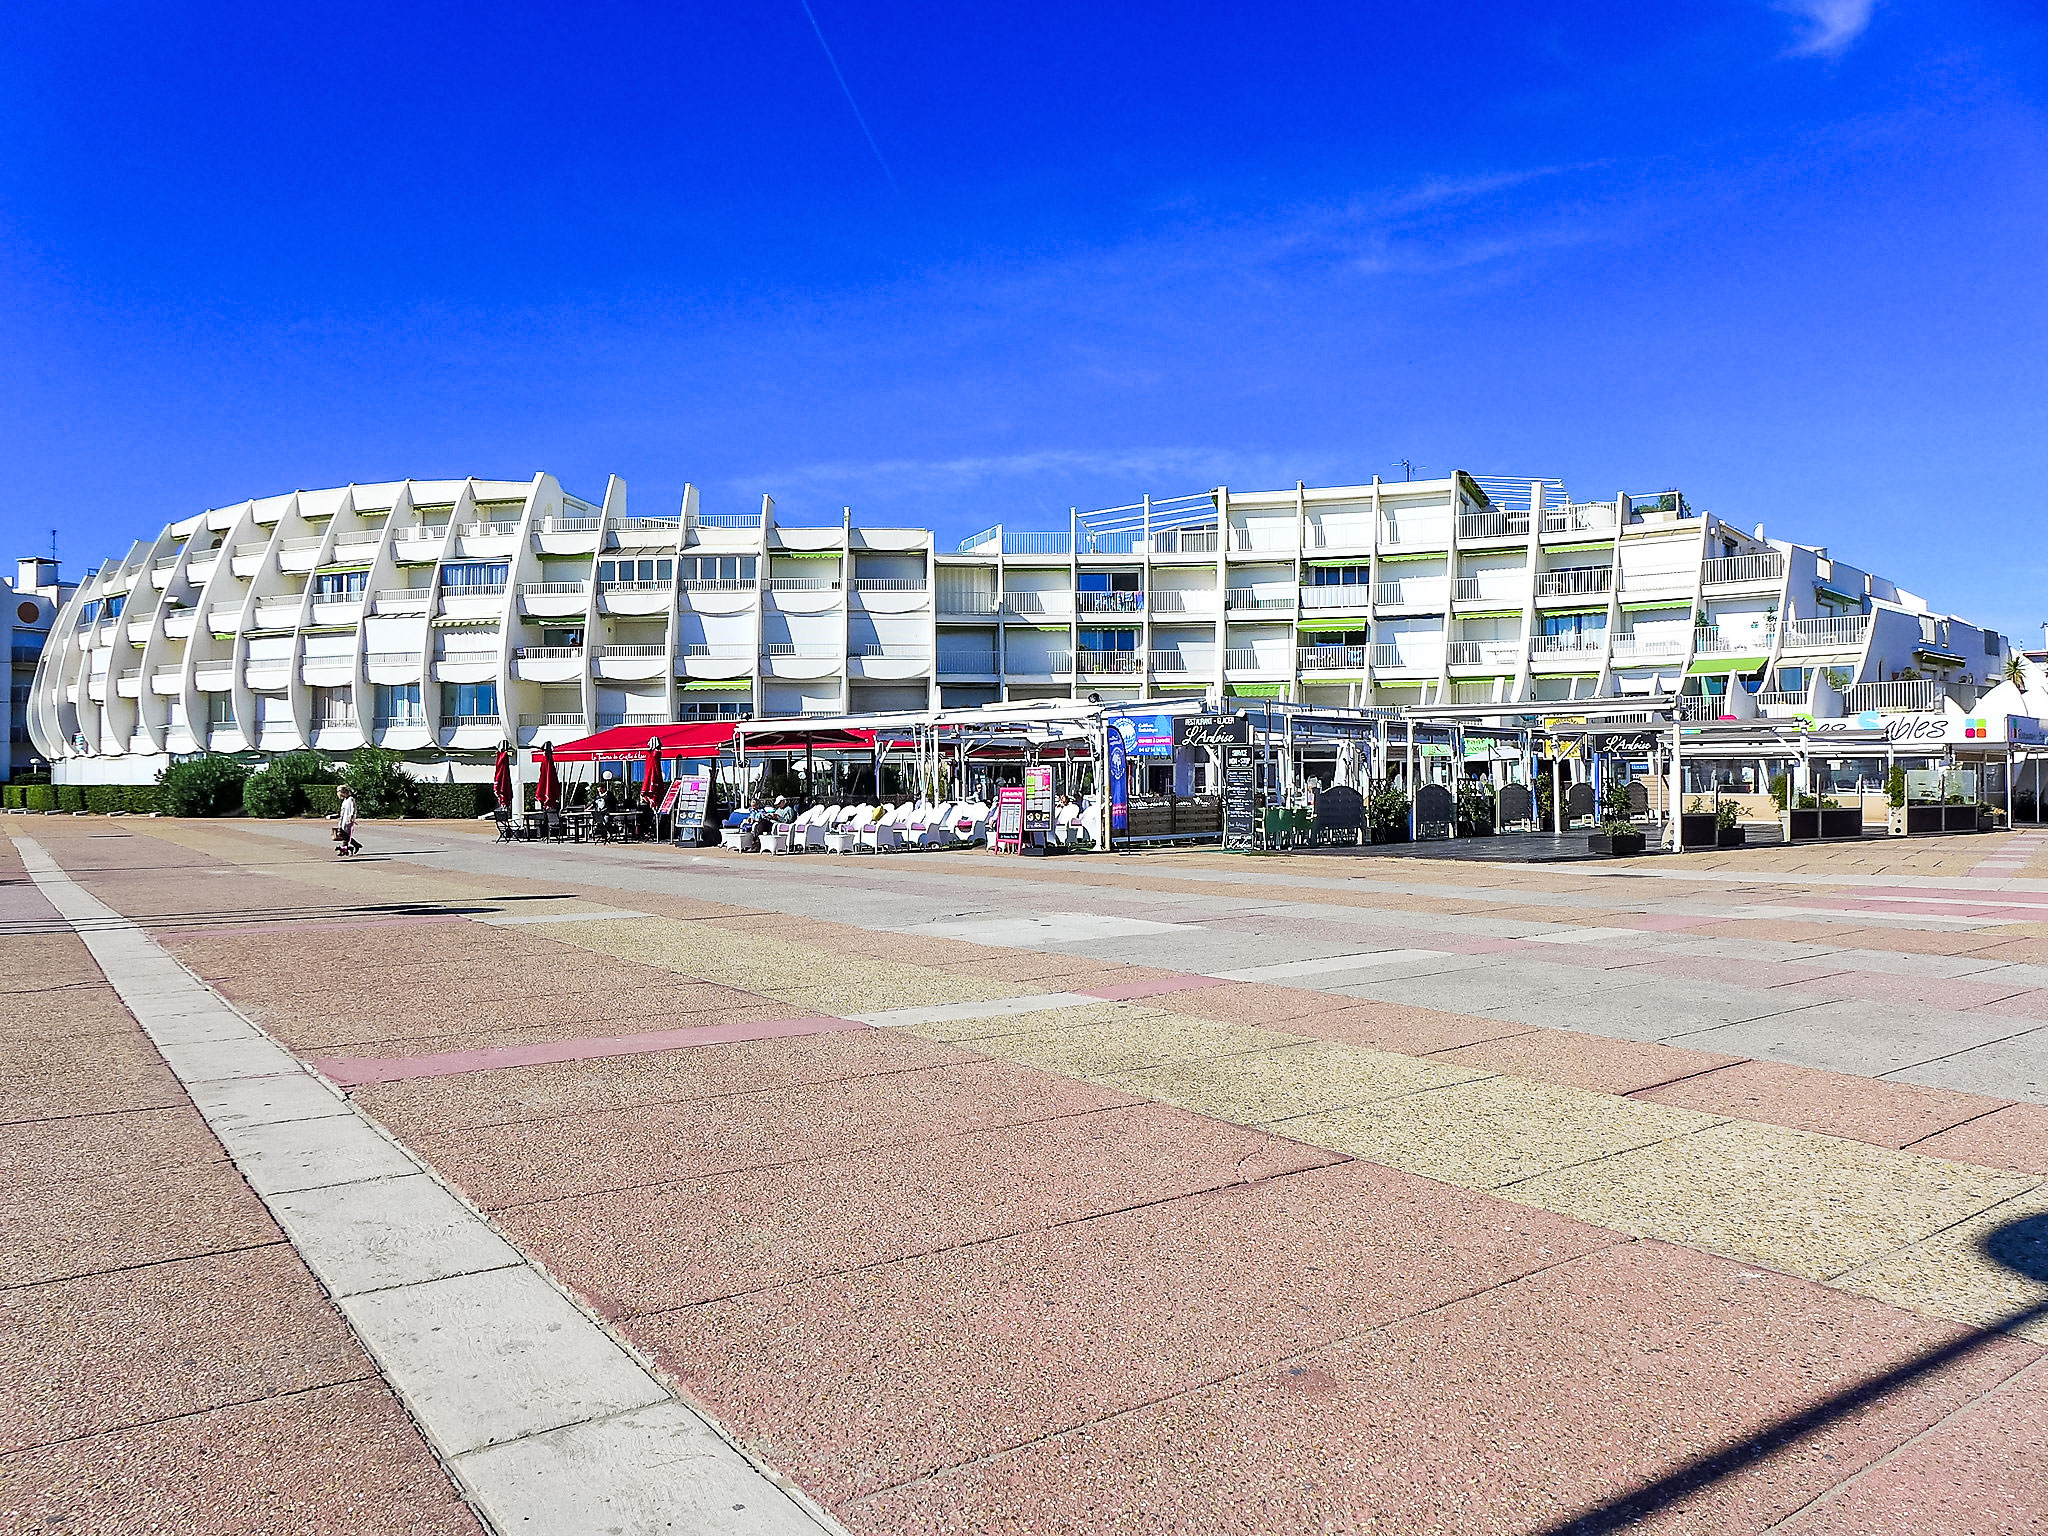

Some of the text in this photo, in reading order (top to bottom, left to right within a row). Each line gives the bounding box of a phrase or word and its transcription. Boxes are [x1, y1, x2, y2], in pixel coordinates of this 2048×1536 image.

[1185, 718, 1213, 726] RESTAURANT
[1217, 716, 1235, 725] GLACIER
[1181, 724, 1235, 747] L'Ardoise
[1602, 734, 1652, 753] L'Ardoise
